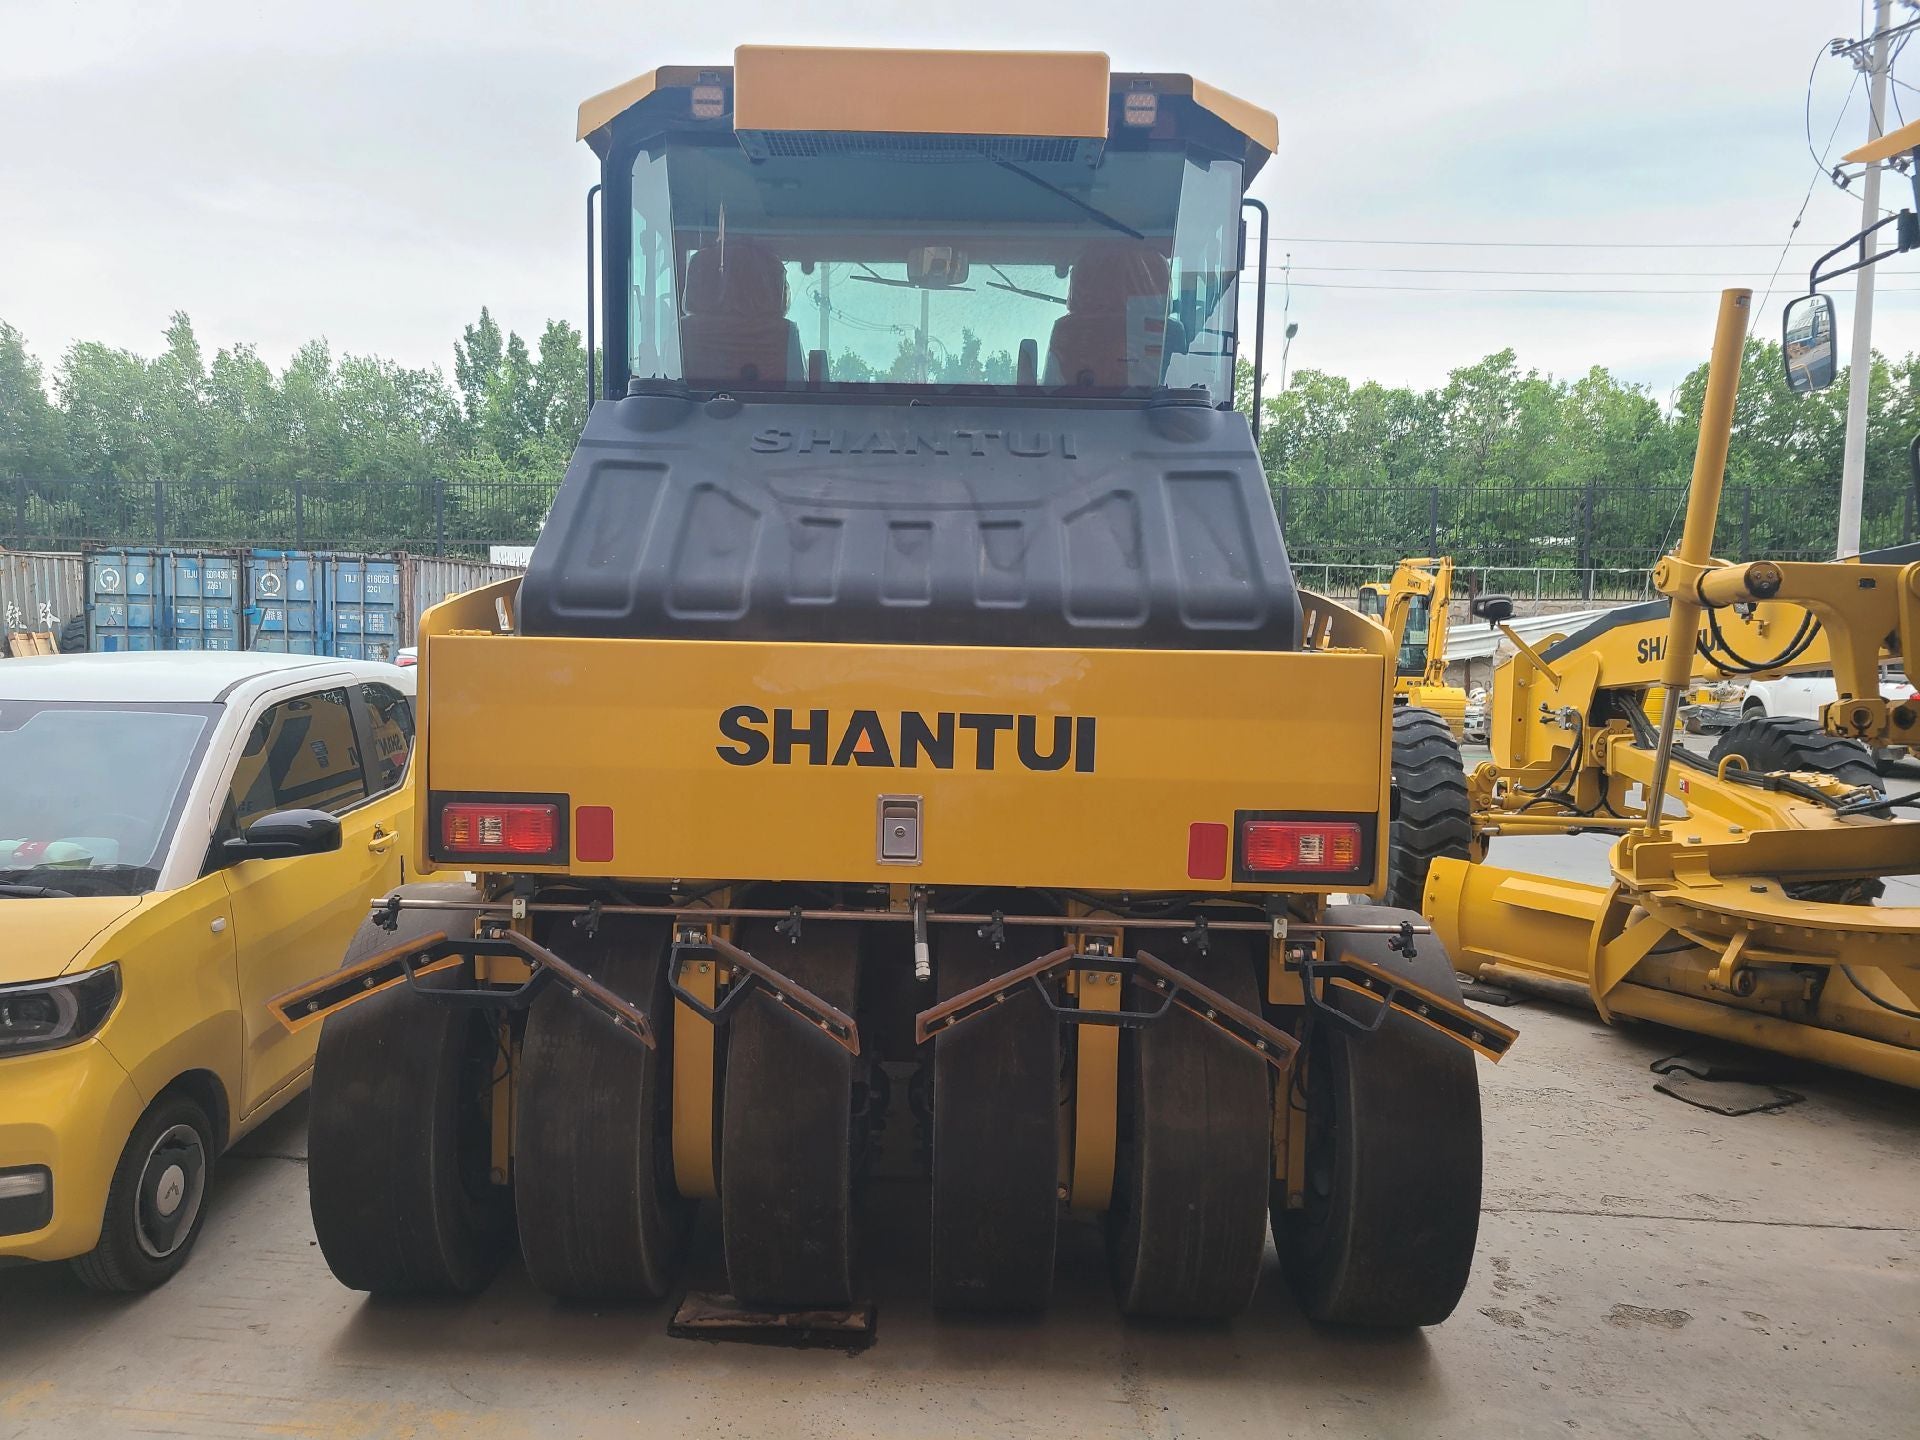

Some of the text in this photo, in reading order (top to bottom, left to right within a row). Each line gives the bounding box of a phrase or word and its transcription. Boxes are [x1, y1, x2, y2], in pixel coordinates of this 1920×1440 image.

[750, 429, 1077, 460] SHANTUI
[366, 574, 390, 584] 616029
[715, 705, 1097, 773] SHANTUI
